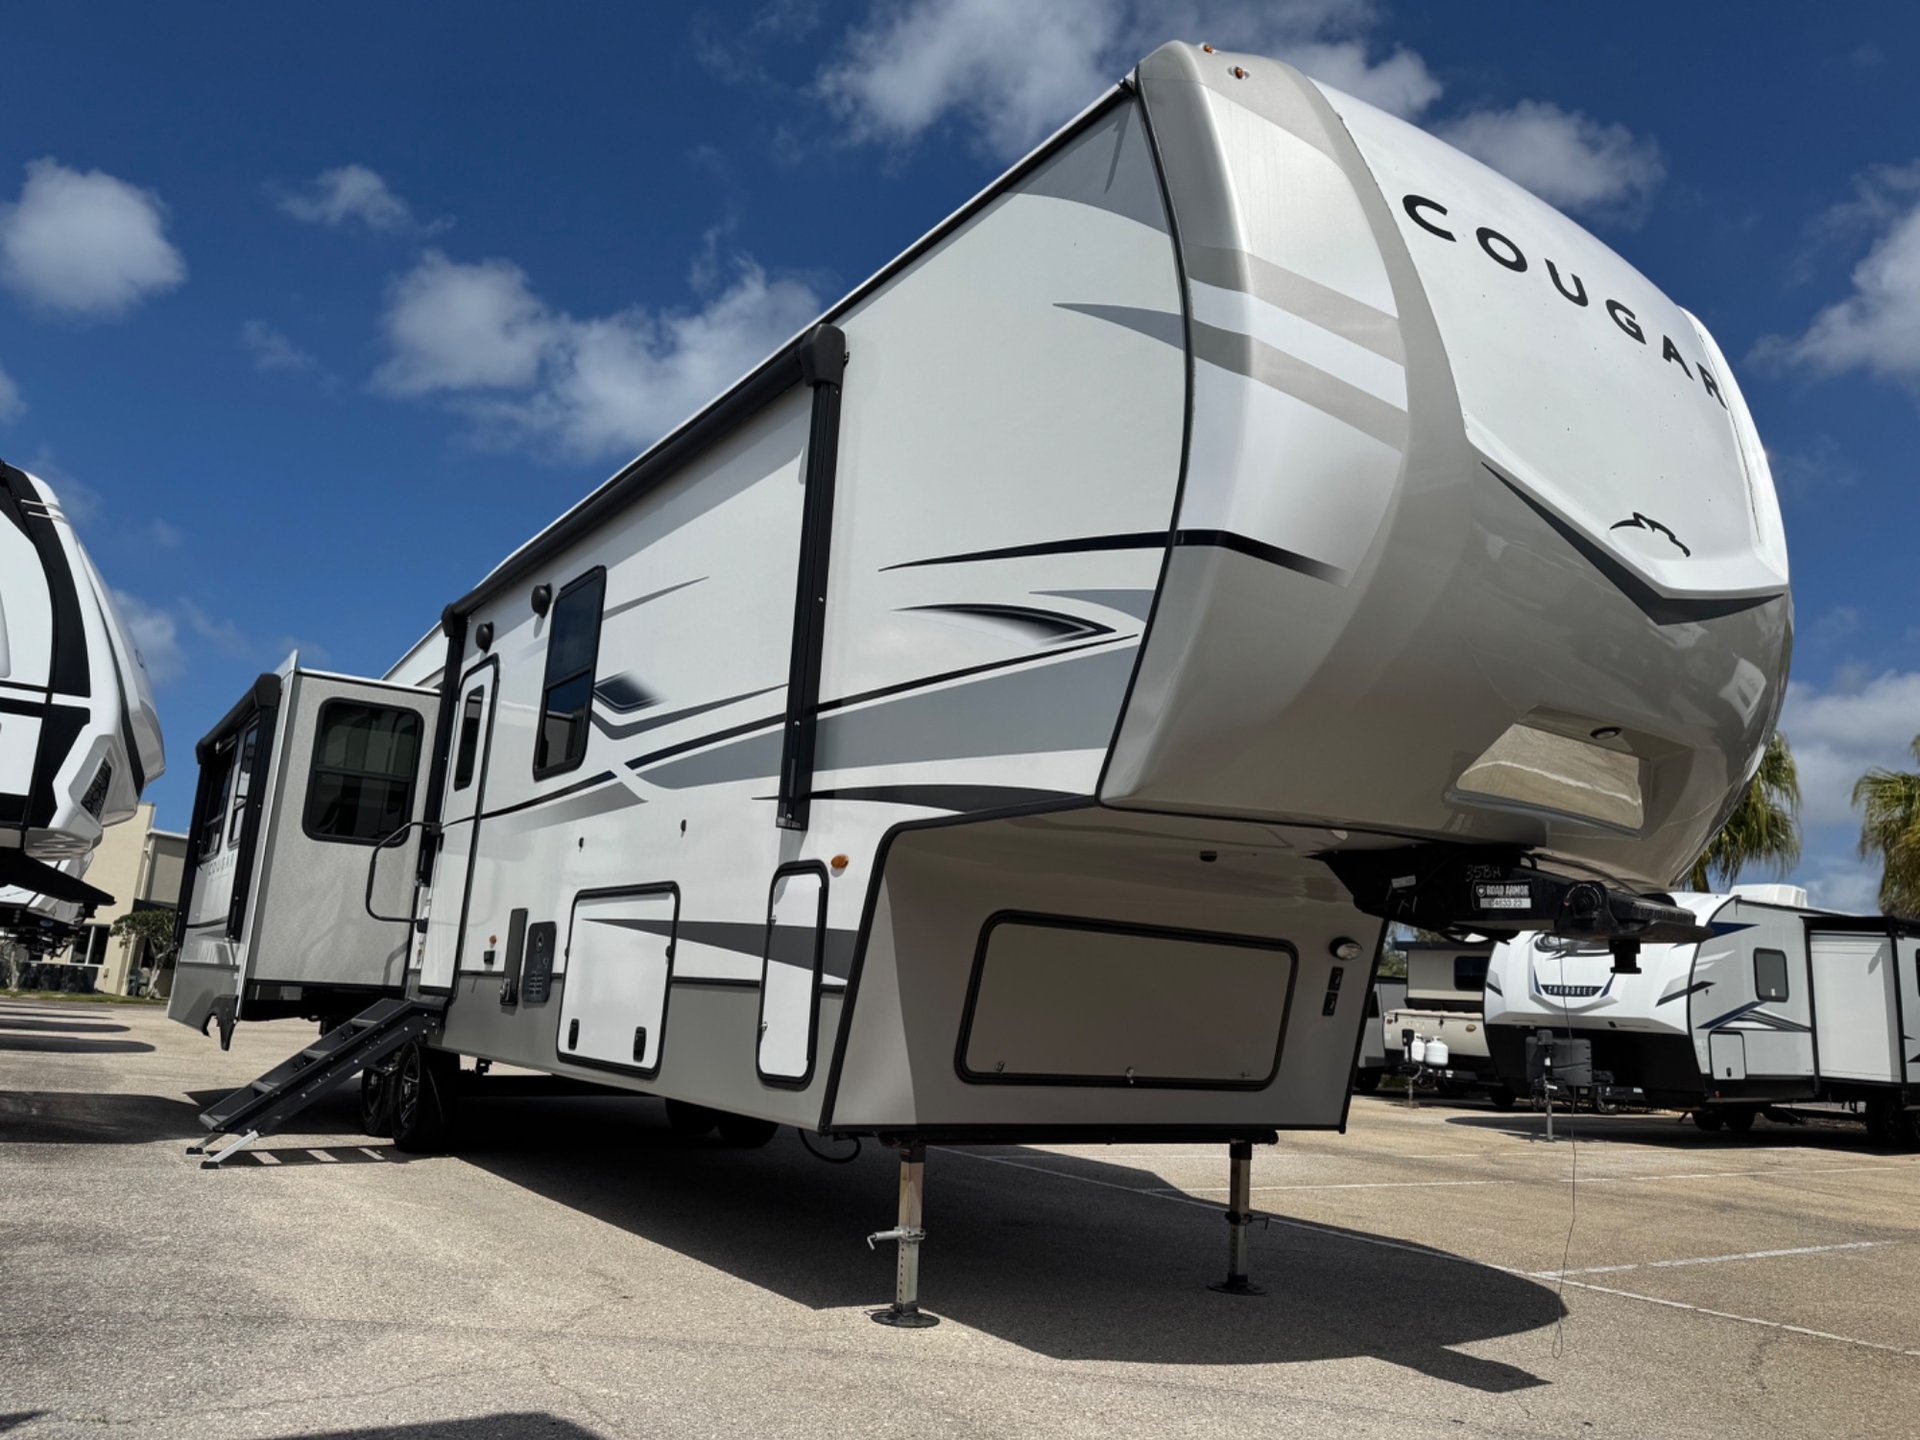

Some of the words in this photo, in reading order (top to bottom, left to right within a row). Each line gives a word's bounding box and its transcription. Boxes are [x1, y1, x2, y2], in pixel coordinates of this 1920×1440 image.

[1402, 194, 1728, 410] COUGAR
[1486, 885, 1504, 896] ROAD
[1505, 884, 1529, 896] ARMOR
[1547, 985, 1593, 995] CHEROKEE
